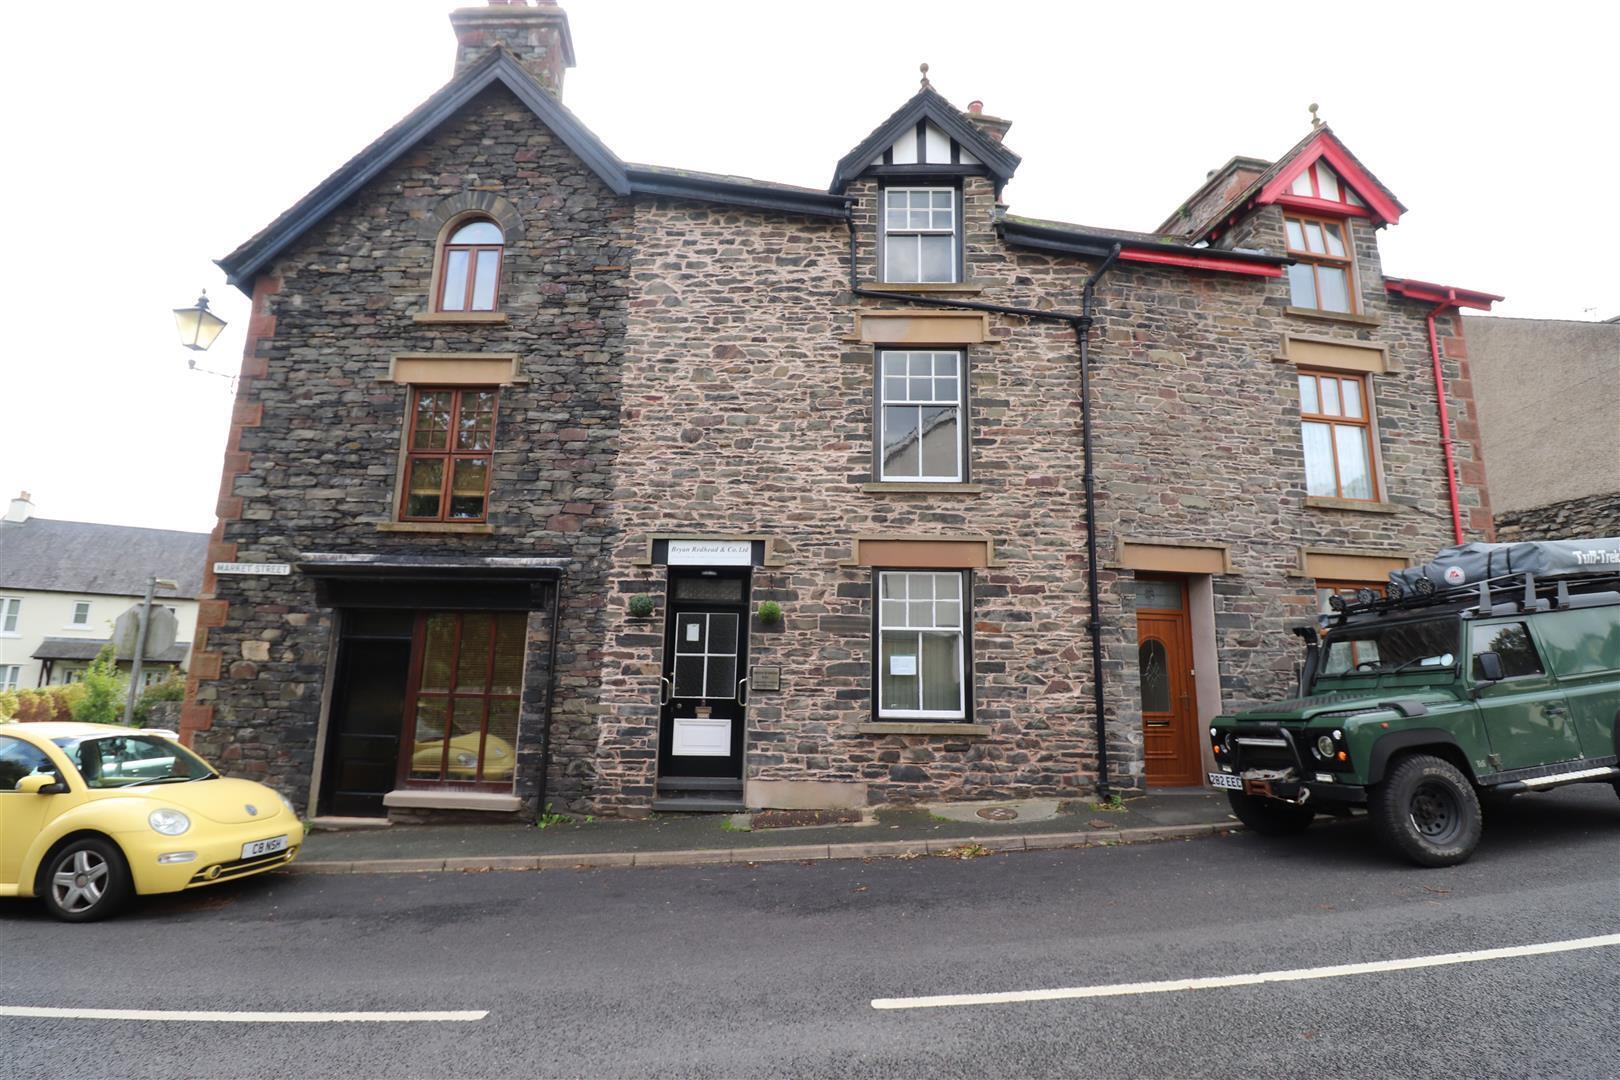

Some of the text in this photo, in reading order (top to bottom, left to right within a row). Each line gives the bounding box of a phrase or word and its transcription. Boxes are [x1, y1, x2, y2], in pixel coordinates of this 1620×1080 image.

[671, 545, 690, 554] Bryan
[691, 545, 718, 553] Redhead
[719, 545, 725, 553] &
[738, 545, 748, 553] Ltd
[216, 563, 289, 574] MARKET STREET
